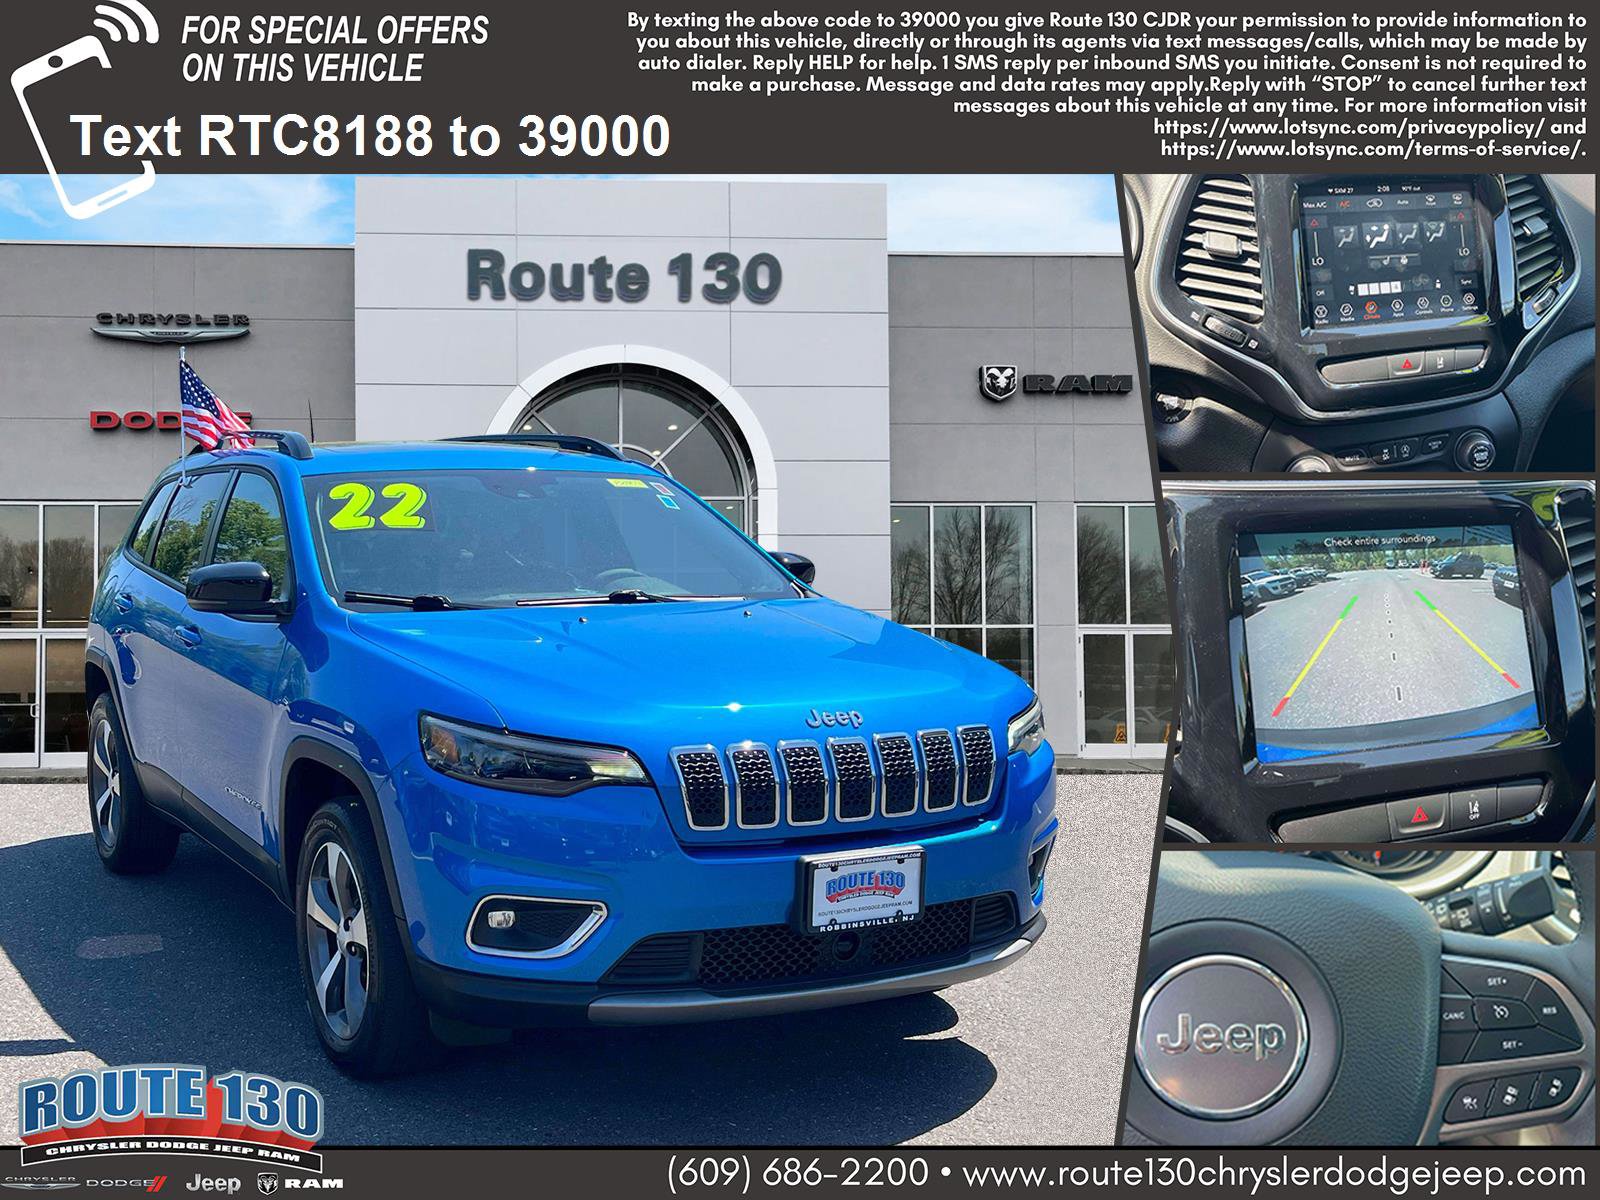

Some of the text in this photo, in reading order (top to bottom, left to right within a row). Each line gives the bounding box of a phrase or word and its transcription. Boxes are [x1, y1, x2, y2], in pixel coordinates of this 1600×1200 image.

[466, 248, 783, 305] Route 130
[96, 312, 250, 326] CHRYSLER
[1022, 374, 1133, 394] RAM
[328, 482, 427, 531] 22
[1324, 534, 1436, 547] Check entire surroundings
[805, 708, 863, 729] Jeep
[826, 870, 906, 896] ROUTE 130
[902, 914, 914, 922] NJ
[1156, 1013, 1287, 1062] Jeep
